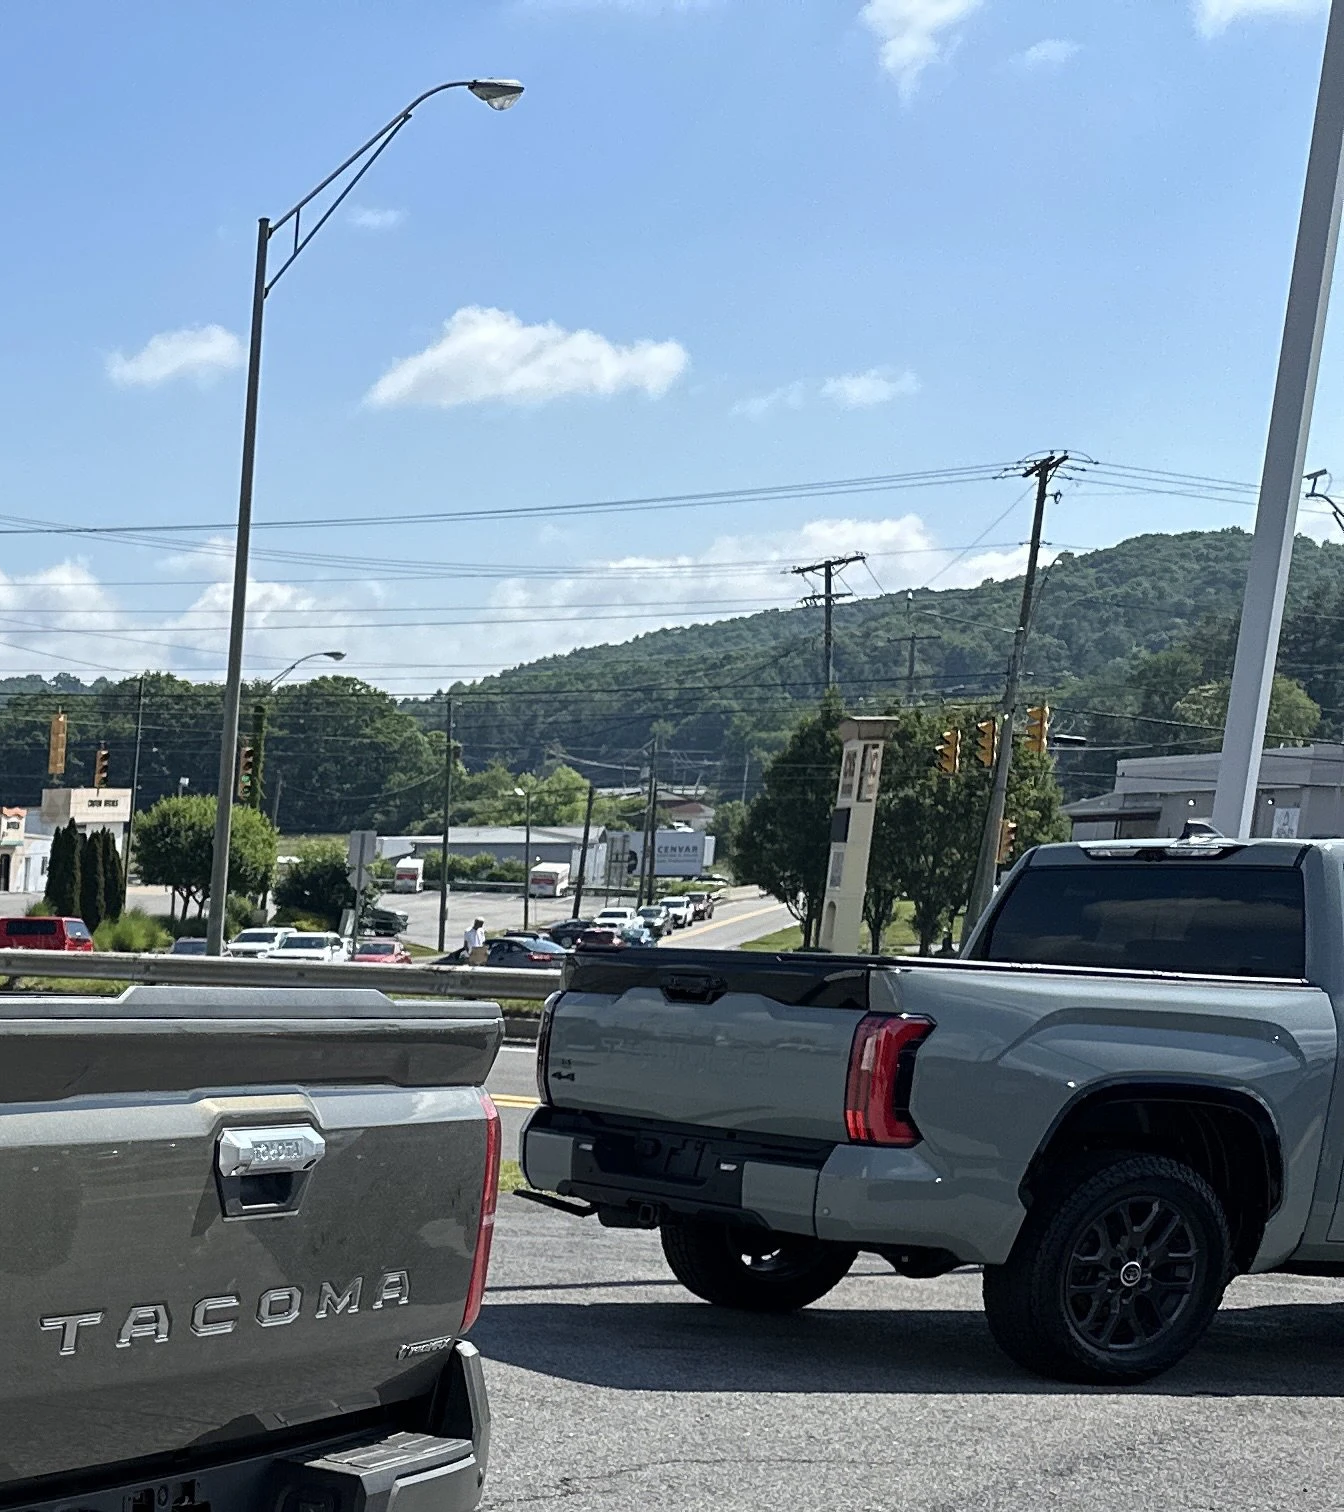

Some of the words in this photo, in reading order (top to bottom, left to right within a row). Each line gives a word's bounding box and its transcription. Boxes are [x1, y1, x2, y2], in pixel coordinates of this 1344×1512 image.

[657, 845, 699, 854] CENVAR
[253, 1142, 301, 1161] TOYOTA
[39, 1269, 411, 1356] TACOMA
